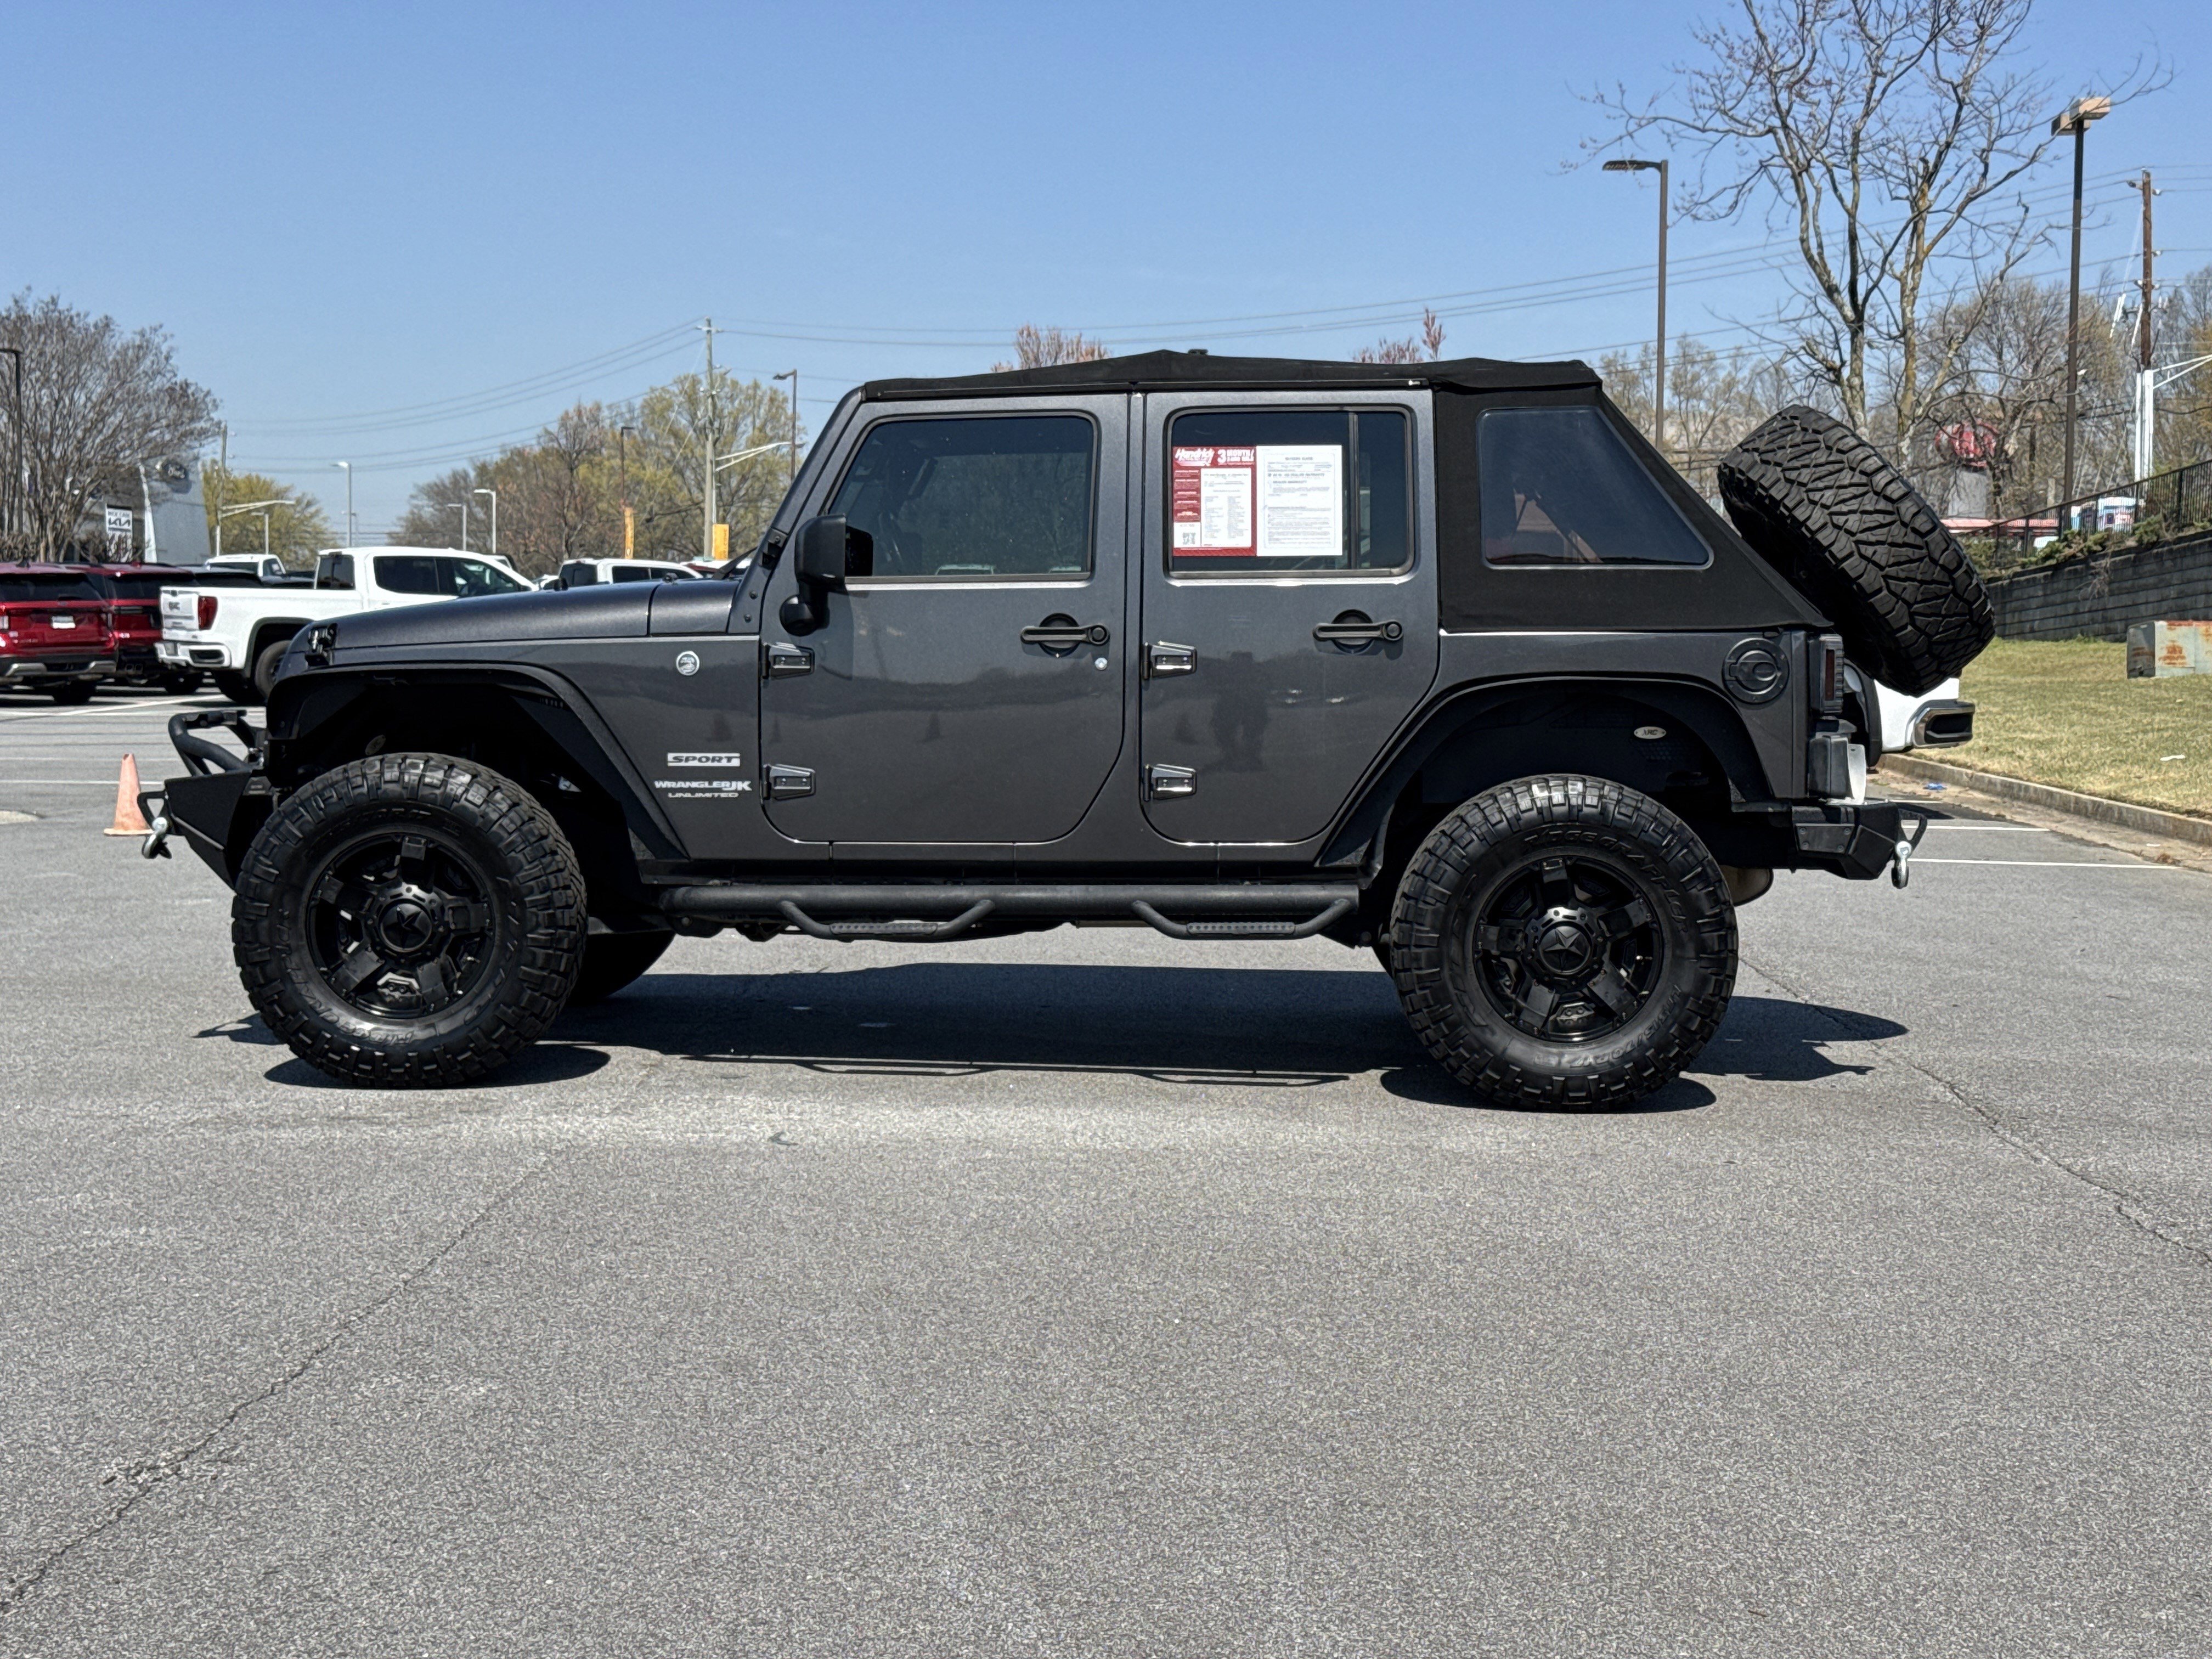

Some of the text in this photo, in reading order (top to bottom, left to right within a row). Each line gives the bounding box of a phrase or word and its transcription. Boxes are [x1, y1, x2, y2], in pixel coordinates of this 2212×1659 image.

[1217, 449, 1226, 464] 3
[668, 755, 740, 764] SPORT
[654, 781, 731, 789] WRANGLER
